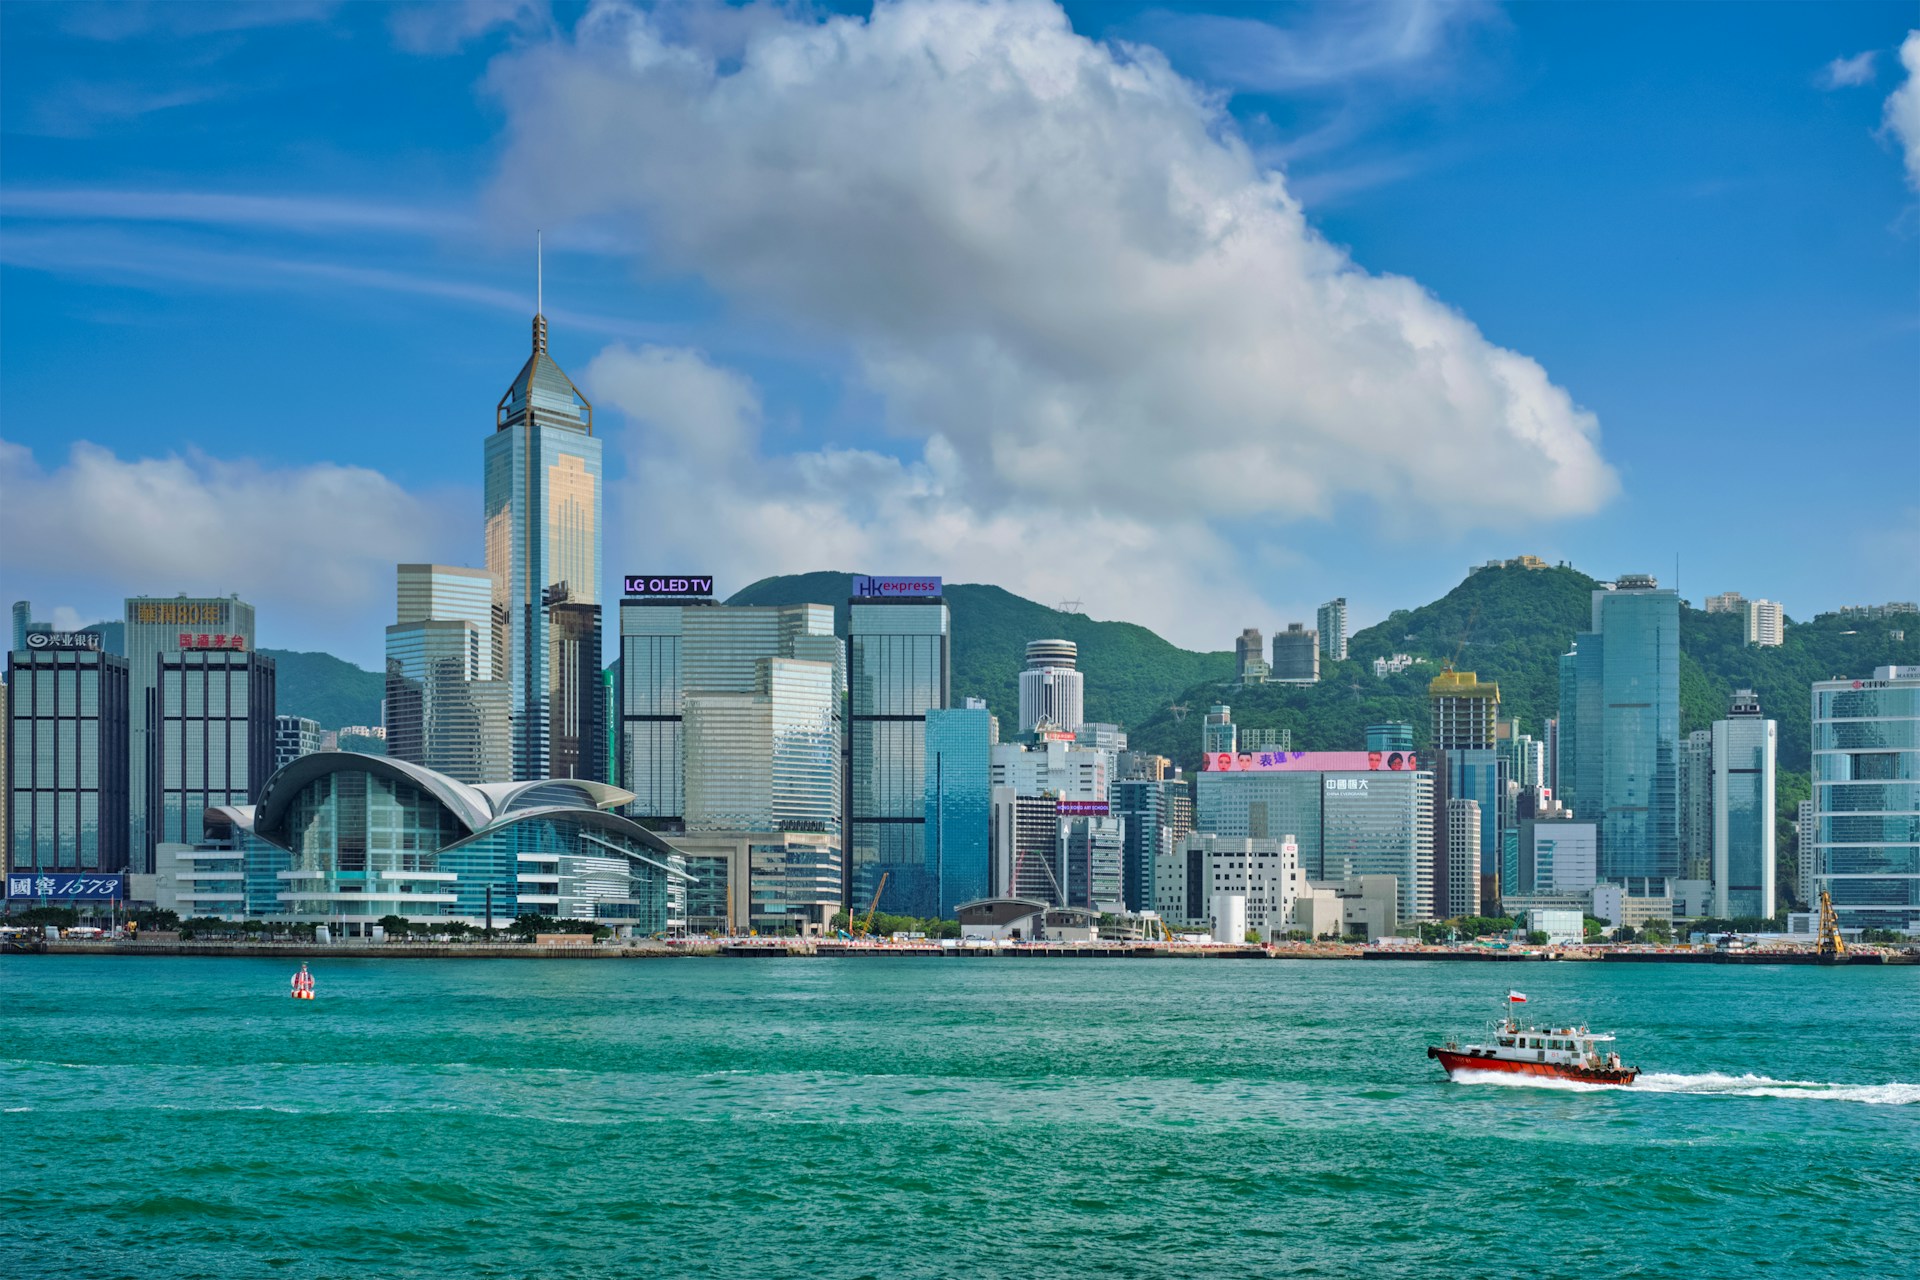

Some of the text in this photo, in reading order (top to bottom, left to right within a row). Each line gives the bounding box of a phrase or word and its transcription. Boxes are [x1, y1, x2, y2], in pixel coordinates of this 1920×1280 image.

[626, 579, 711, 592] LG OLED TV
[48, 633, 99, 647] 兴业银行
[179, 633, 244, 648] 国酒茅台
[1862, 681, 1890, 689] CITIC
[58, 878, 118, 895] 1573
